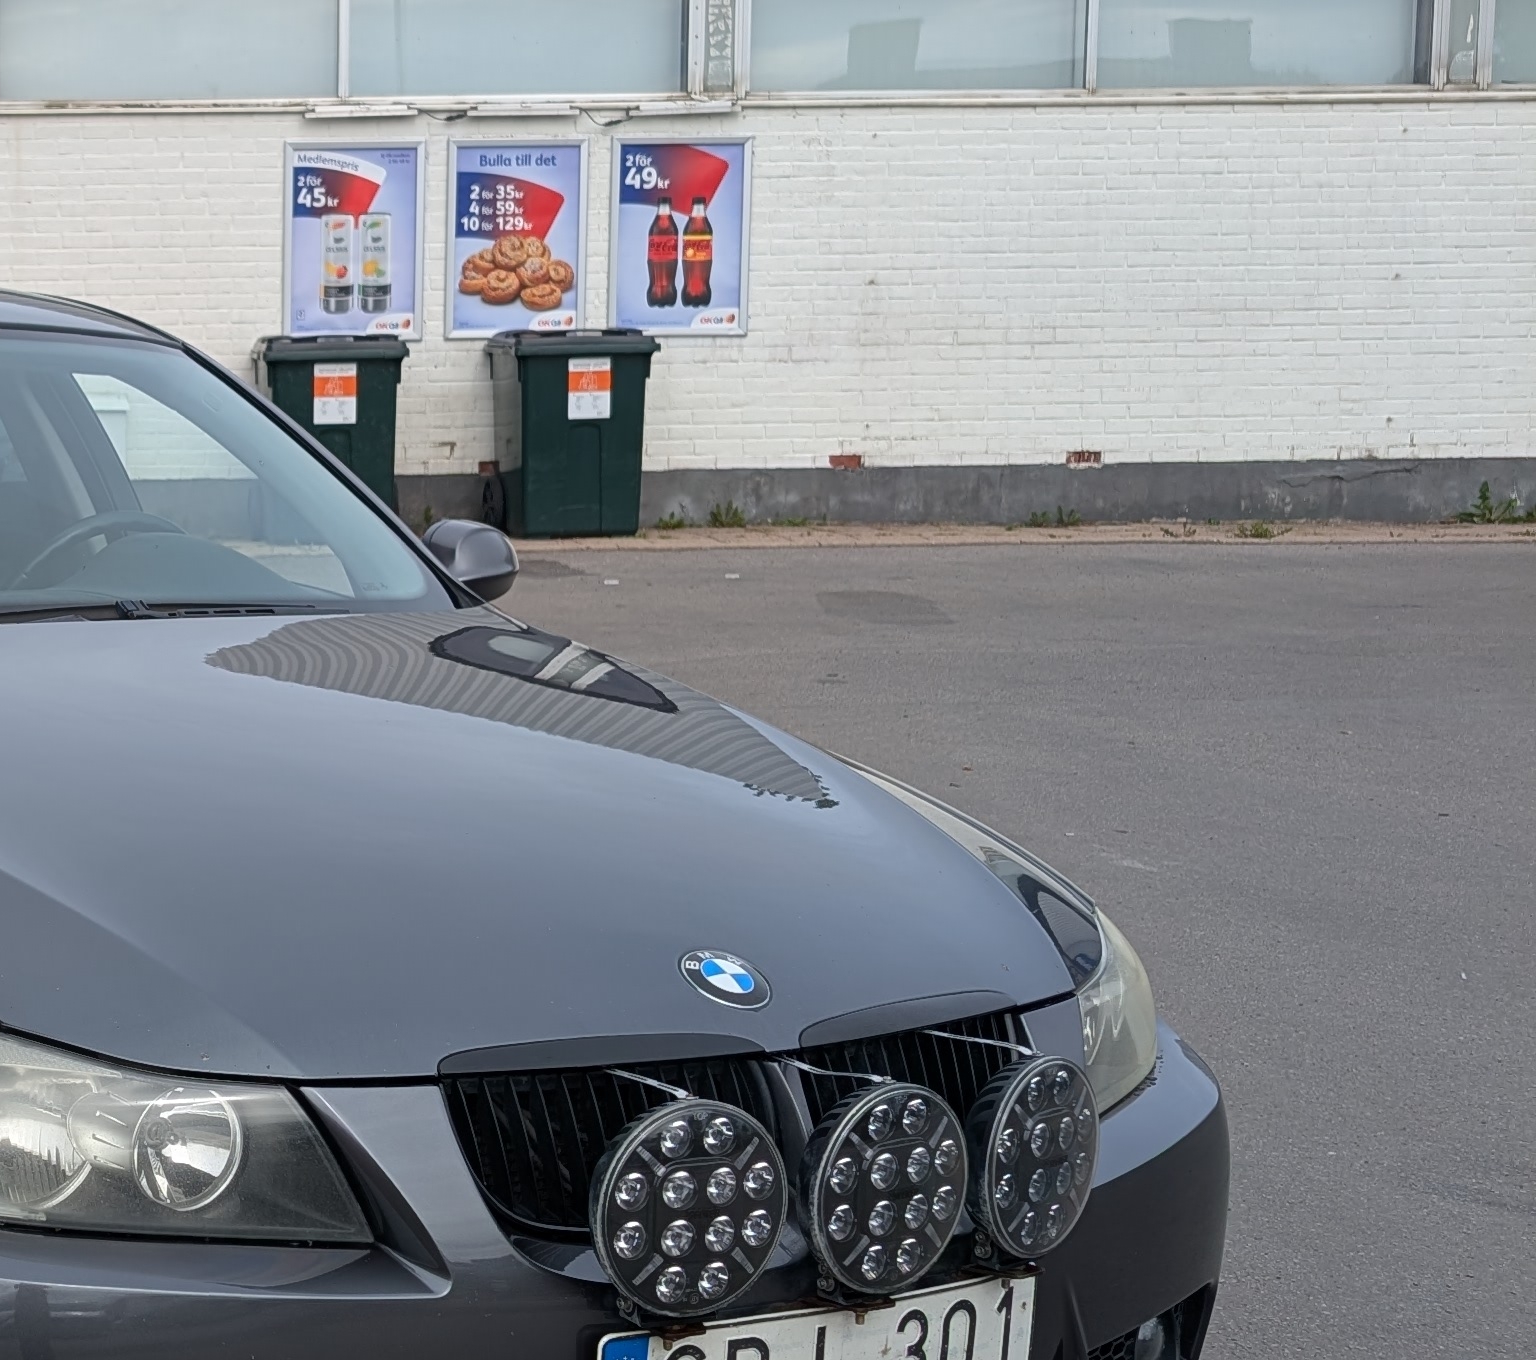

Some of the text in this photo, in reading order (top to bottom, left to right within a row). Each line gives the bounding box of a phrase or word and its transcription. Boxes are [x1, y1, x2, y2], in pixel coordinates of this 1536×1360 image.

[297, 153, 360, 172] Medlemspris
[479, 153, 557, 167] Bulla till det
[625, 153, 653, 167] 2 för
[297, 175, 306, 187] 2
[469, 185, 480, 200] 2
[469, 201, 480, 215] 4
[460, 217, 480, 231] 10
